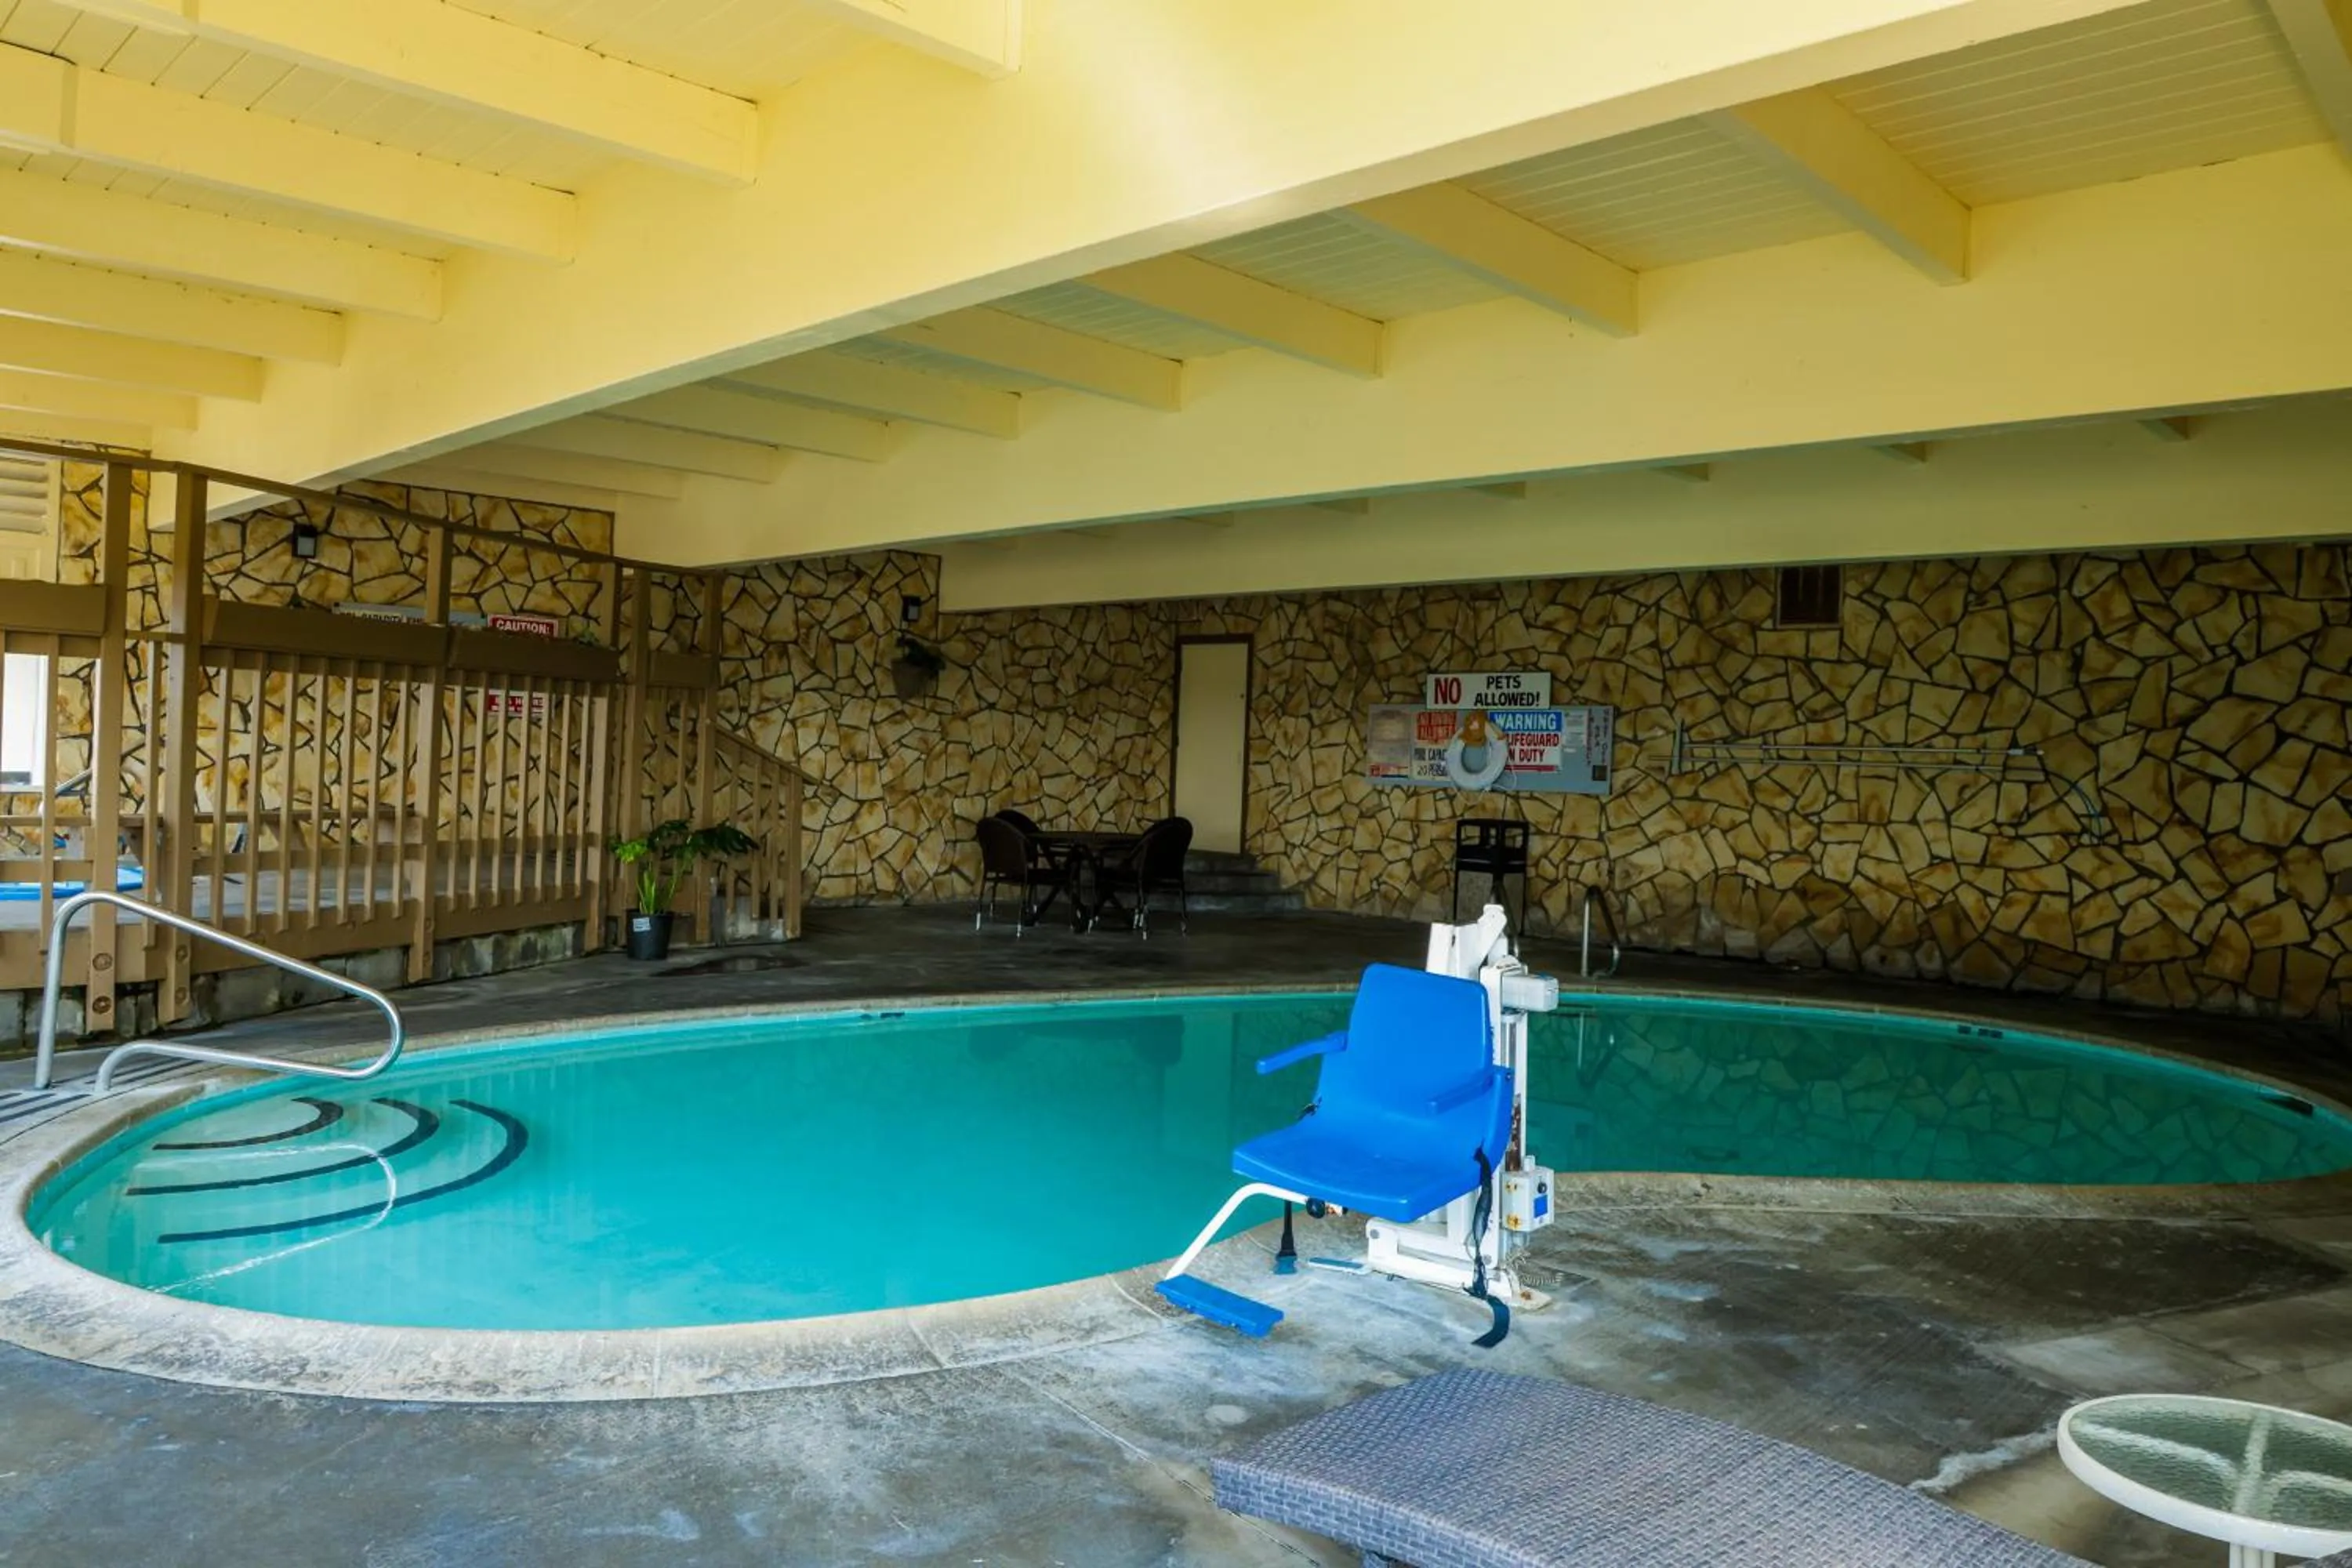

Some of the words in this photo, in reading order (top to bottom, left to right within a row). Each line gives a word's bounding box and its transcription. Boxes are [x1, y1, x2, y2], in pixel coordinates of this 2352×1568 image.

[1486, 675, 1521, 690] PETS
[1434, 677, 1461, 704] NO
[1474, 691, 1540, 706] ALLOWED!
[1494, 713, 1556, 730] WARNING
[1519, 749, 1544, 762] DUTY
